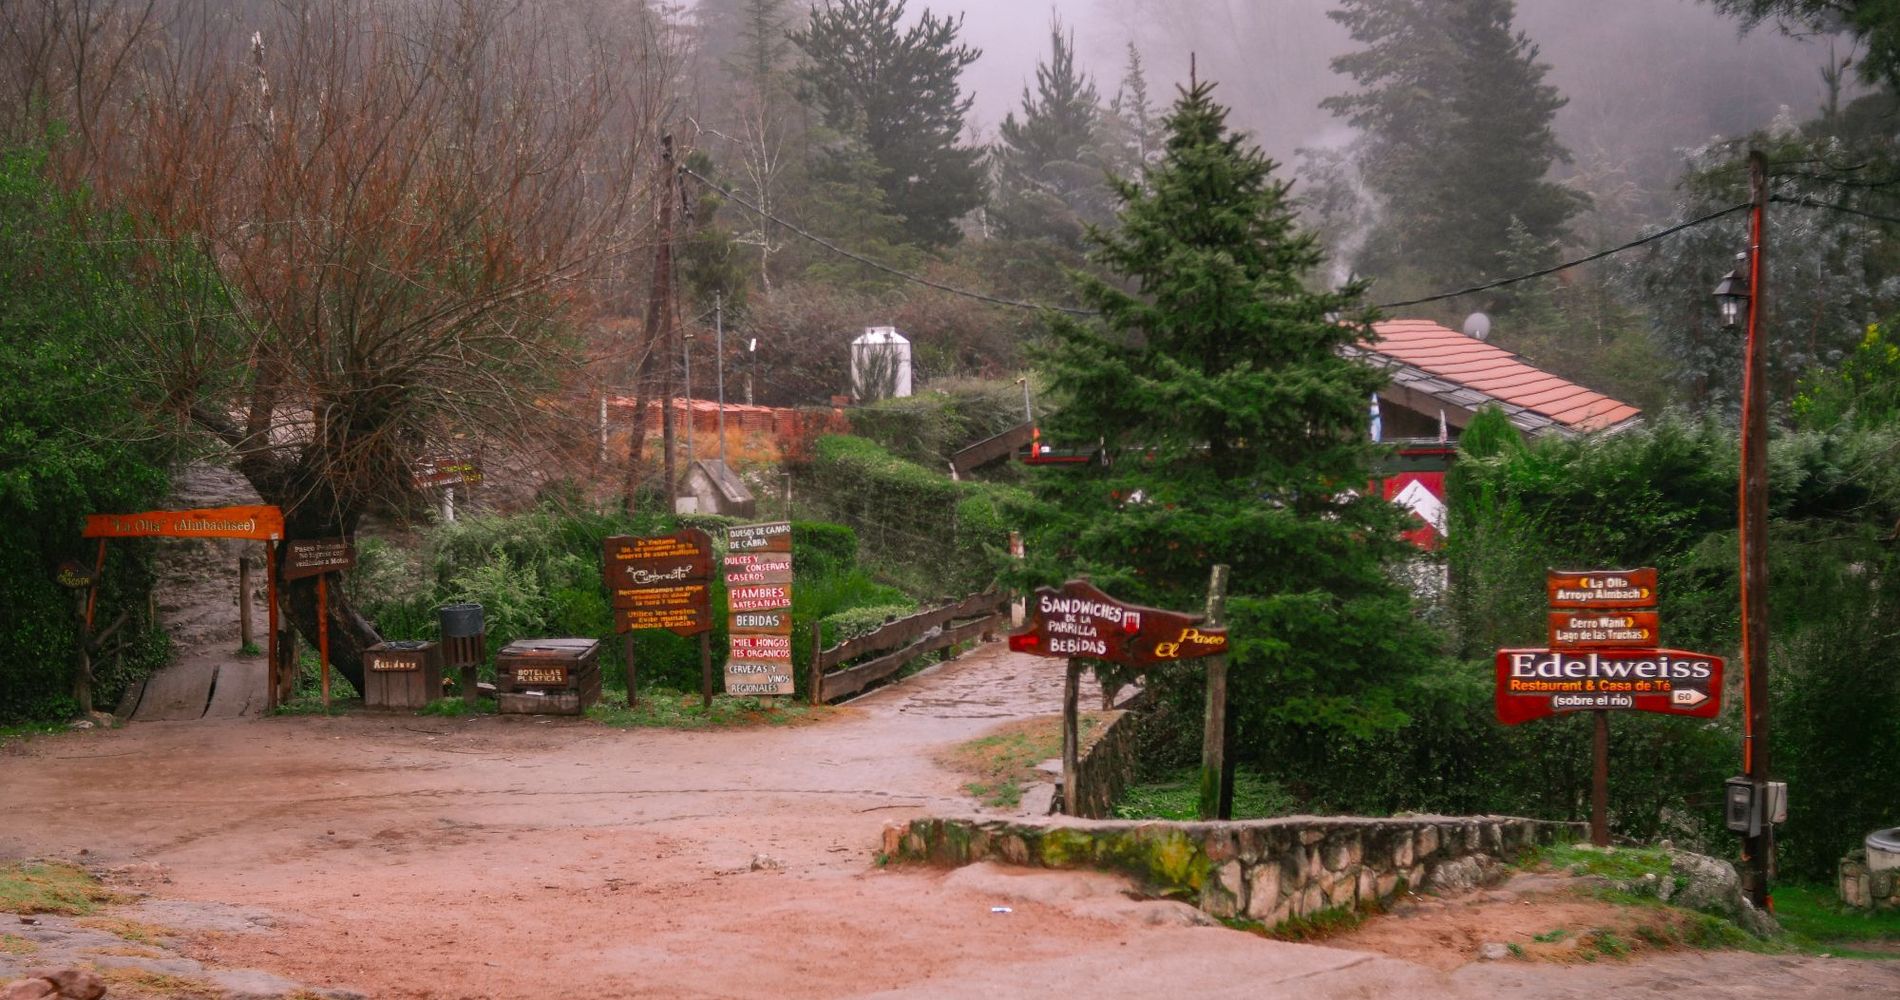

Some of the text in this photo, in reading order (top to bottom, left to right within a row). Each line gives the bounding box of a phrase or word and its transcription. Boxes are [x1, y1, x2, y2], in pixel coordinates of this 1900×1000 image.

[756, 527, 765, 535] DE
[765, 525, 791, 534] CAMPO
[730, 538, 768, 549] DE CABRA
[724, 555, 758, 565] DULCES Y
[746, 562, 790, 572] CONSERVAS
[727, 573, 764, 582] CASEROS
[1589, 578, 1628, 588] La Olla
[731, 587, 784, 599] FIAMBRES
[1557, 589, 1594, 601] Arroyo
[733, 598, 791, 609] ARTESANALES
[736, 615, 779, 626] BEBIDAS
[1065, 614, 1091, 624] DE LA
[1570, 617, 1626, 628] Cerro Wank
[1048, 621, 1097, 637] PARRILLA
[1556, 629, 1642, 642] Lago de las Truchas
[733, 638, 789, 647] MIEL HONGOS
[1155, 628, 1225, 657] El Paseo
[733, 649, 790, 658] TES ORGANICOS
[729, 664, 768, 674] CERVEZAS
[1511, 653, 1711, 678] Edelweiss
[767, 674, 790, 683] VINOS
[731, 684, 777, 693] REGIONALES
[1510, 680, 1671, 691] Restaurant & Casa de Té
[1554, 695, 1593, 708] (sobre
[1597, 696, 1609, 706] el
[1678, 693, 1691, 701] 60
